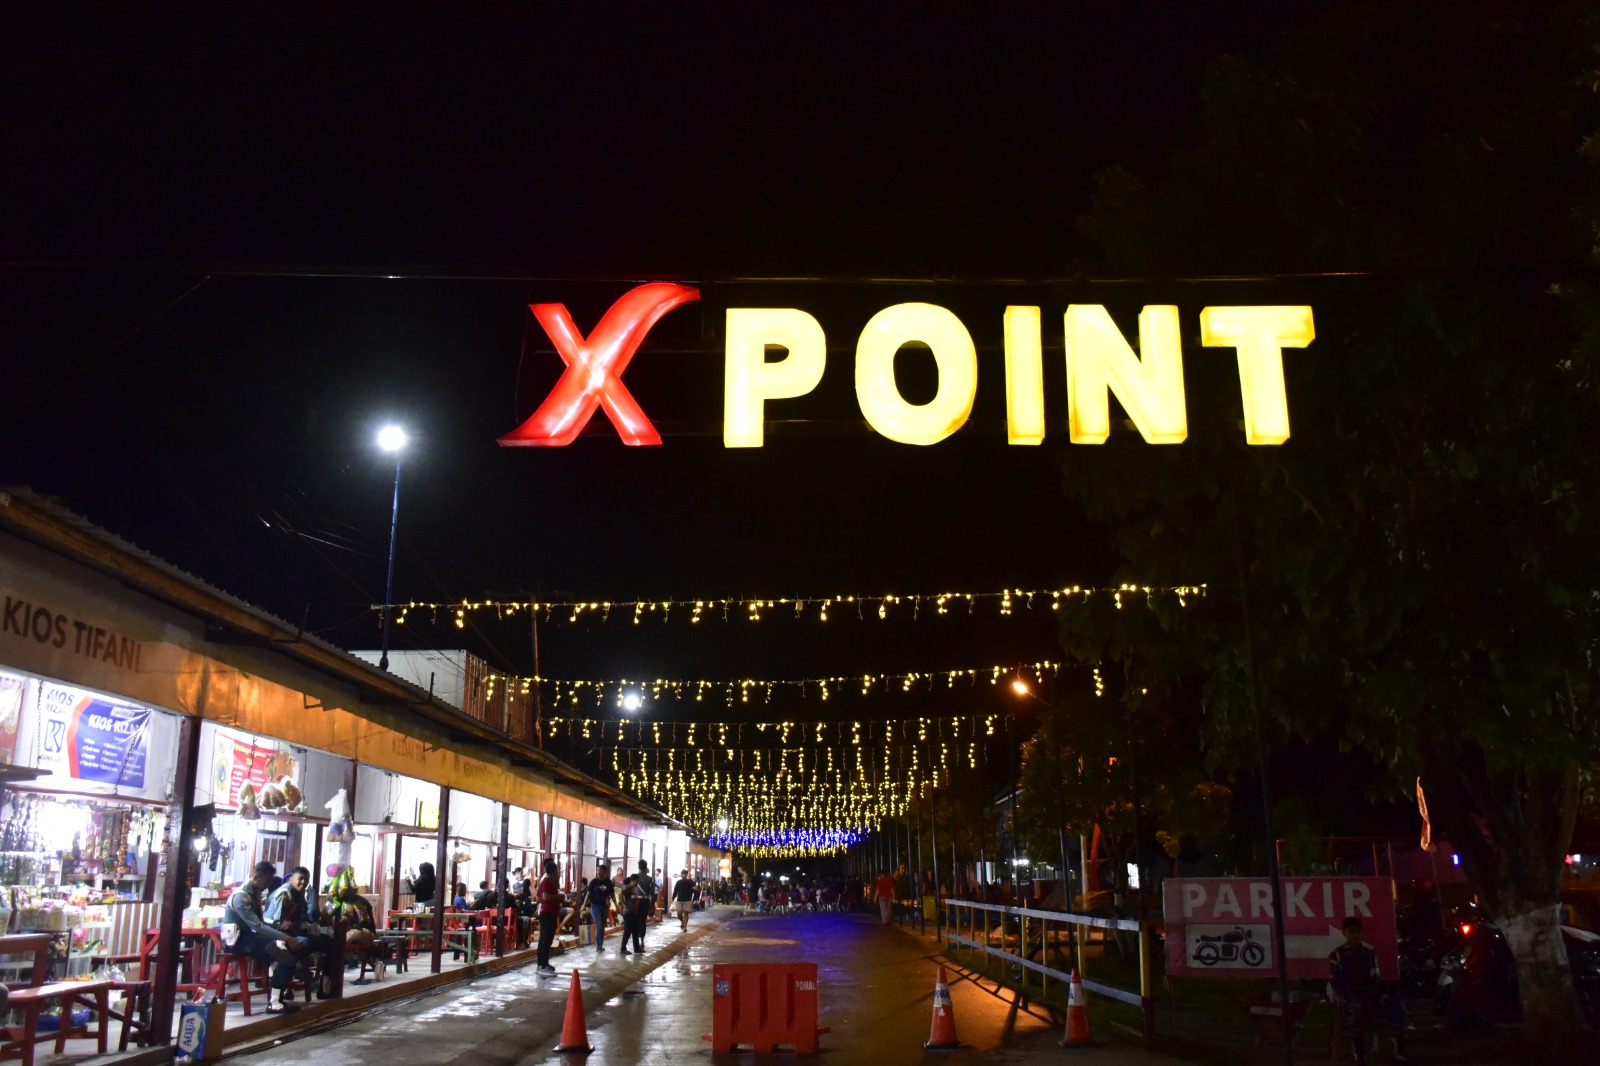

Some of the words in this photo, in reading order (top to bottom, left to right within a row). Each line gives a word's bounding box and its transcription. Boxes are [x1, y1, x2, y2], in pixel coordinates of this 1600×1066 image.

[497, 282, 701, 448] X
[723, 302, 1316, 448] POINT
[2, 595, 68, 649] KIOS
[73, 620, 142, 673] TIFANI
[47, 688, 75, 706] KIOS
[88, 713, 113, 732] KIOS
[1182, 880, 1374, 918] PARKIR
[183, 1017, 195, 1047] AQUA
